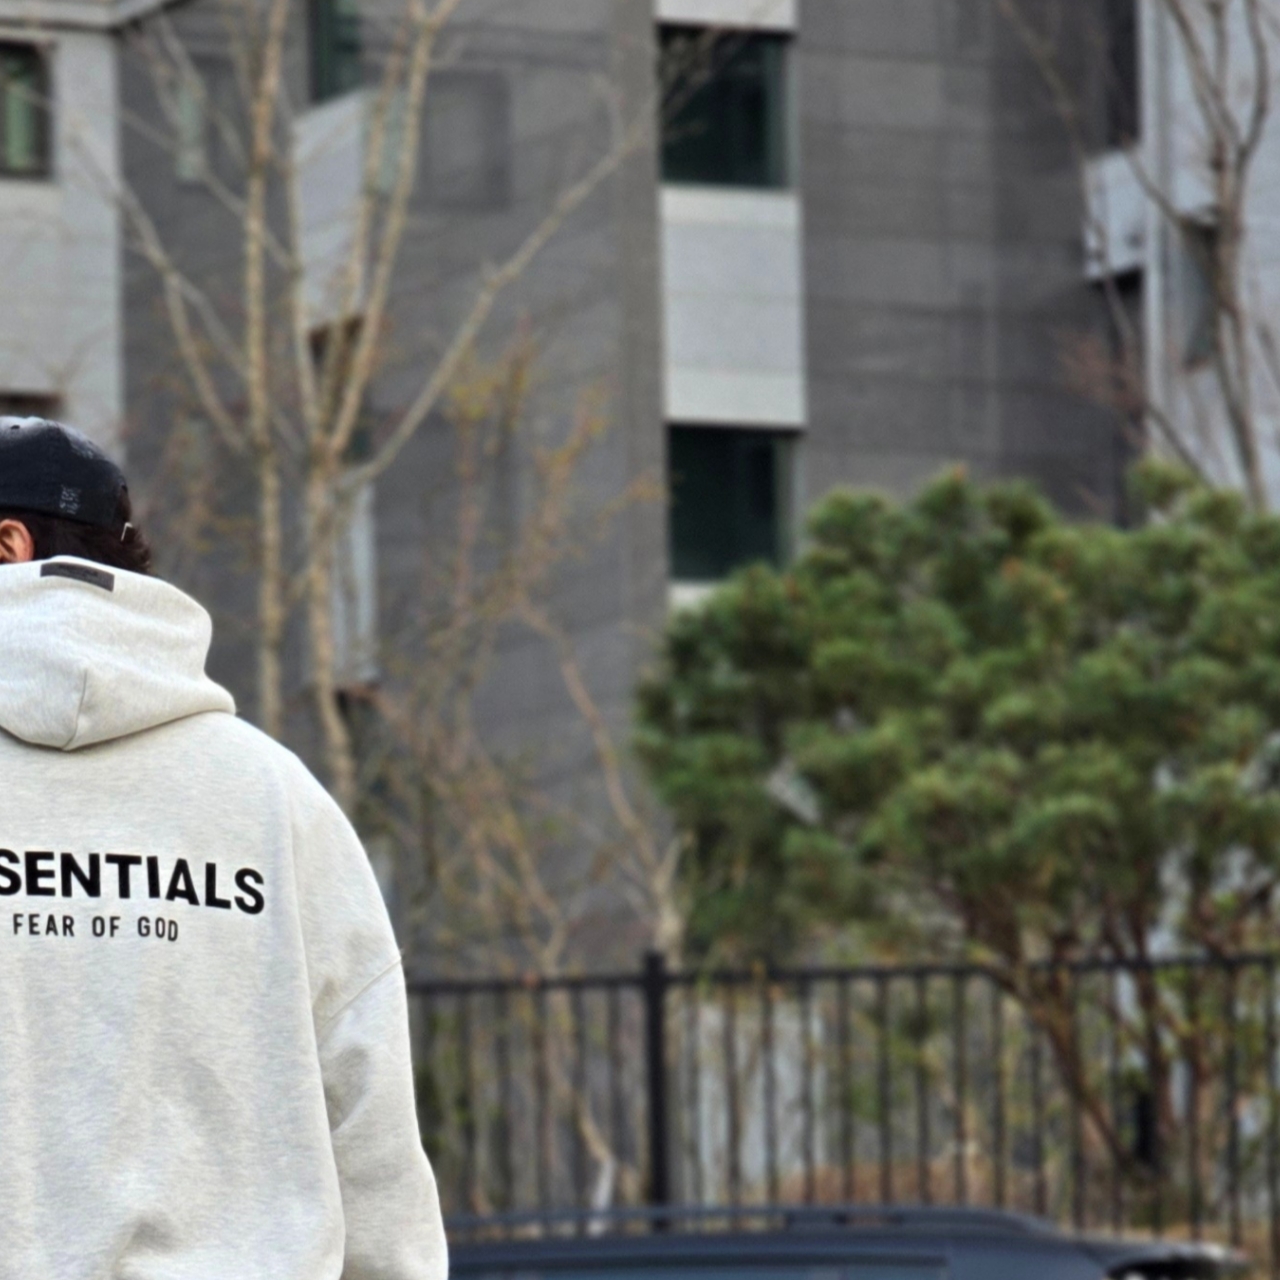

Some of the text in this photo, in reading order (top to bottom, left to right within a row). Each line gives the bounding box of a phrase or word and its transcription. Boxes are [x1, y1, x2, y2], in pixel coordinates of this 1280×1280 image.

[13, 913, 179, 942] FEAR OF GOD
